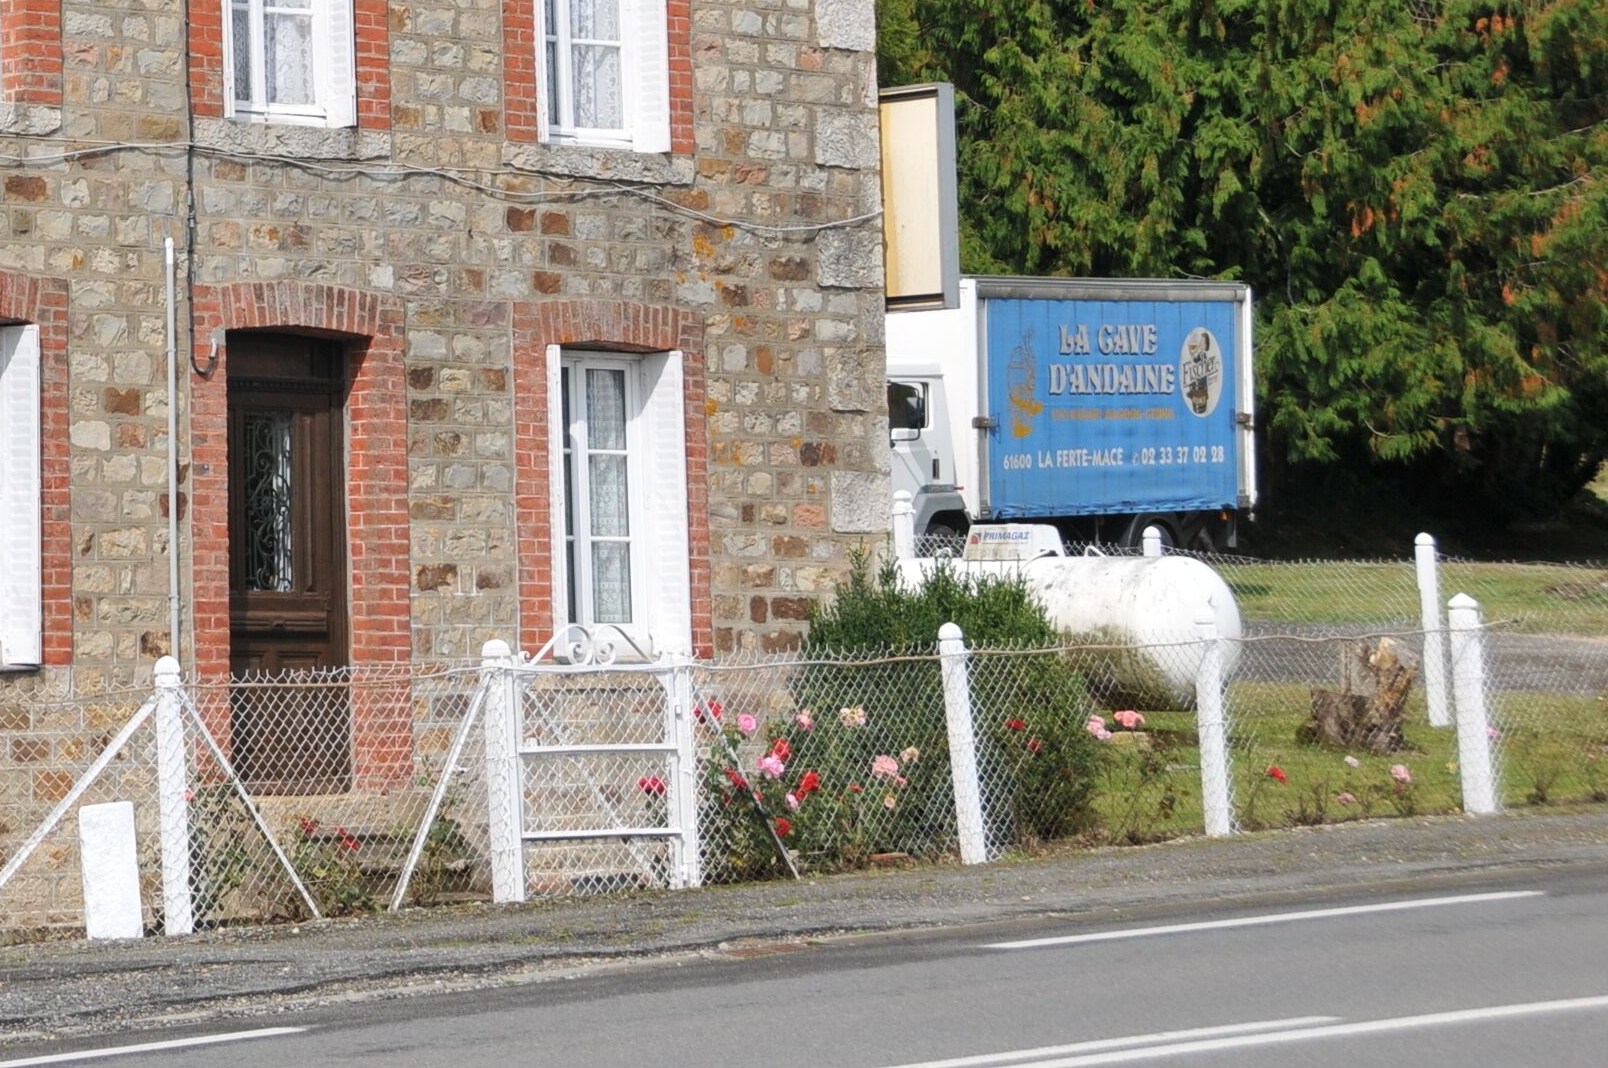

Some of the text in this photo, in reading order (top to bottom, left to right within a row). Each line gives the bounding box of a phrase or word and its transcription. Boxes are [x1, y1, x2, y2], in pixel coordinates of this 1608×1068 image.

[1059, 324, 1159, 356] LA CAVE
[1049, 364, 1175, 395] D'ANDAINE
[1003, 454, 1032, 470] 61600
[1038, 451, 1053, 468] LA
[1141, 448, 1155, 464] 02
[1159, 447, 1173, 464] 33
[1177, 446, 1189, 463] 37
[1193, 446, 1207, 463] 02
[1211, 445, 1225, 463] 28
[983, 531, 1031, 541] PRIMAGAZ
